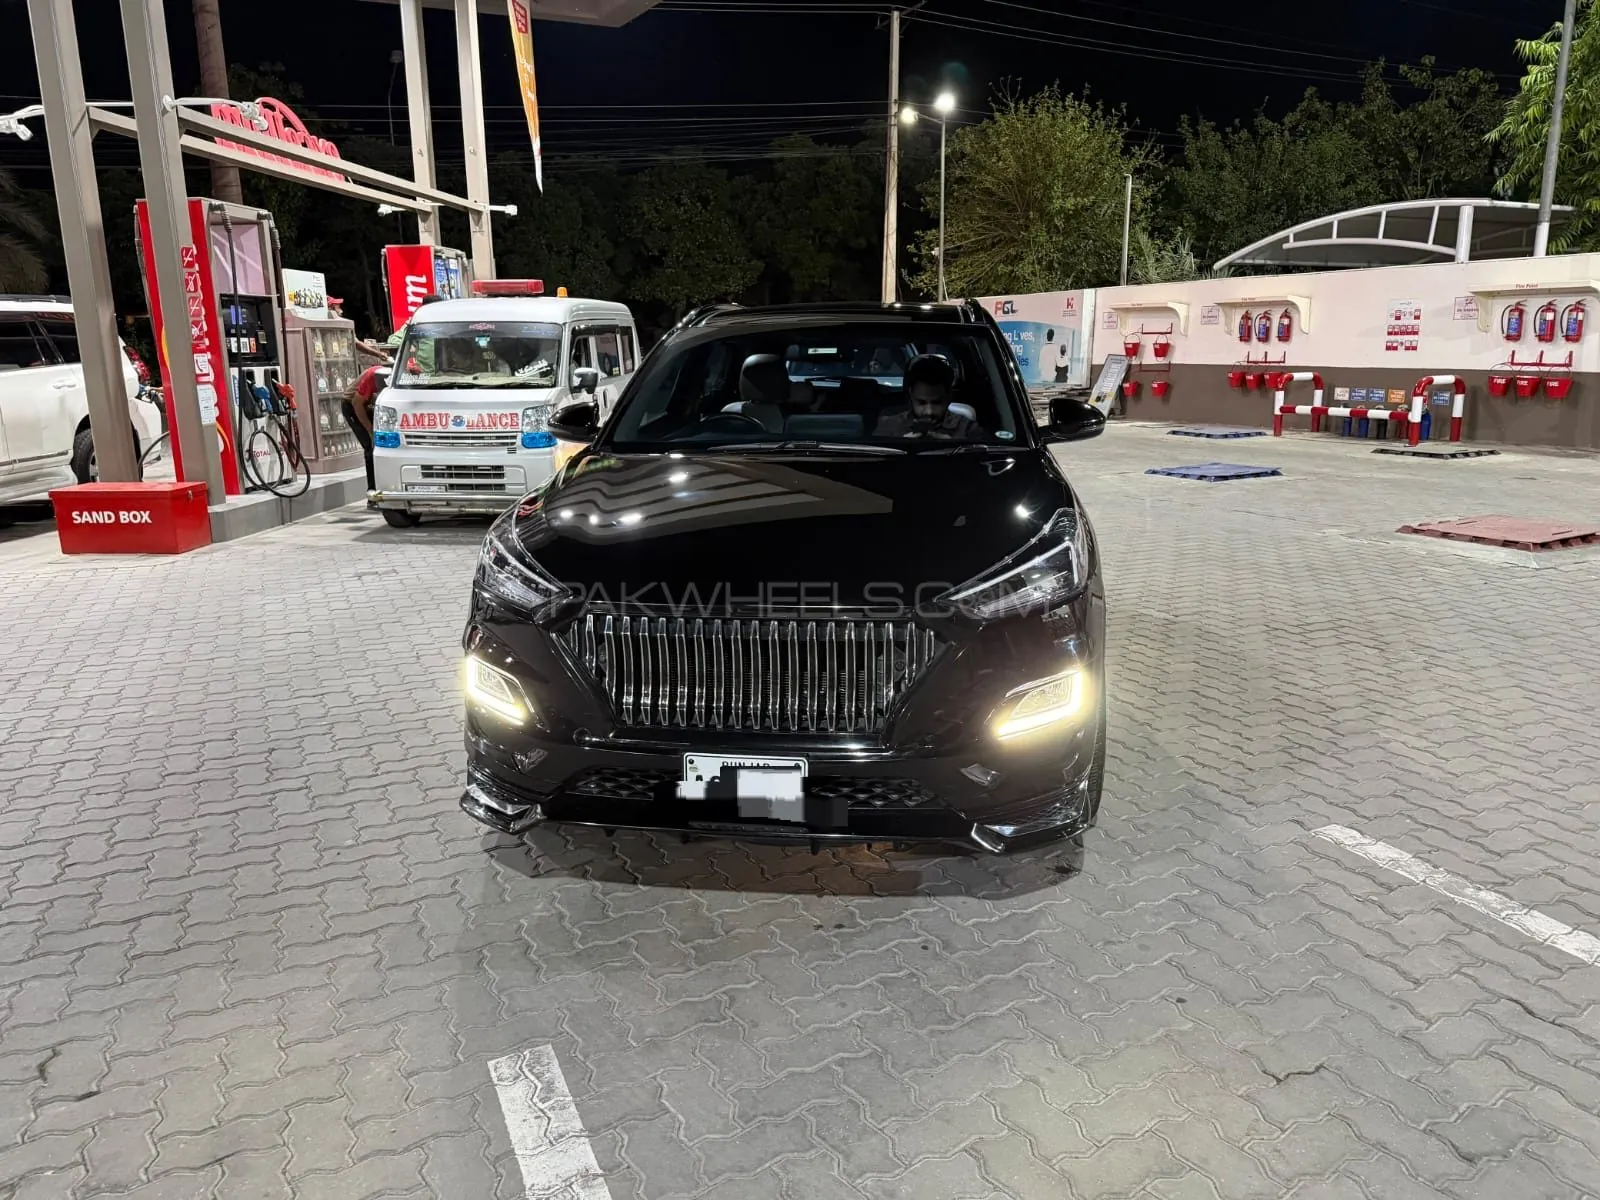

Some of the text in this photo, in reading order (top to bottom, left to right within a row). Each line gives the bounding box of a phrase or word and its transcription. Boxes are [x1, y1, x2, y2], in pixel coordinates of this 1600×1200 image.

[1013, 329, 1035, 343] Lves,
[72, 510, 152, 525] SAND BOX
